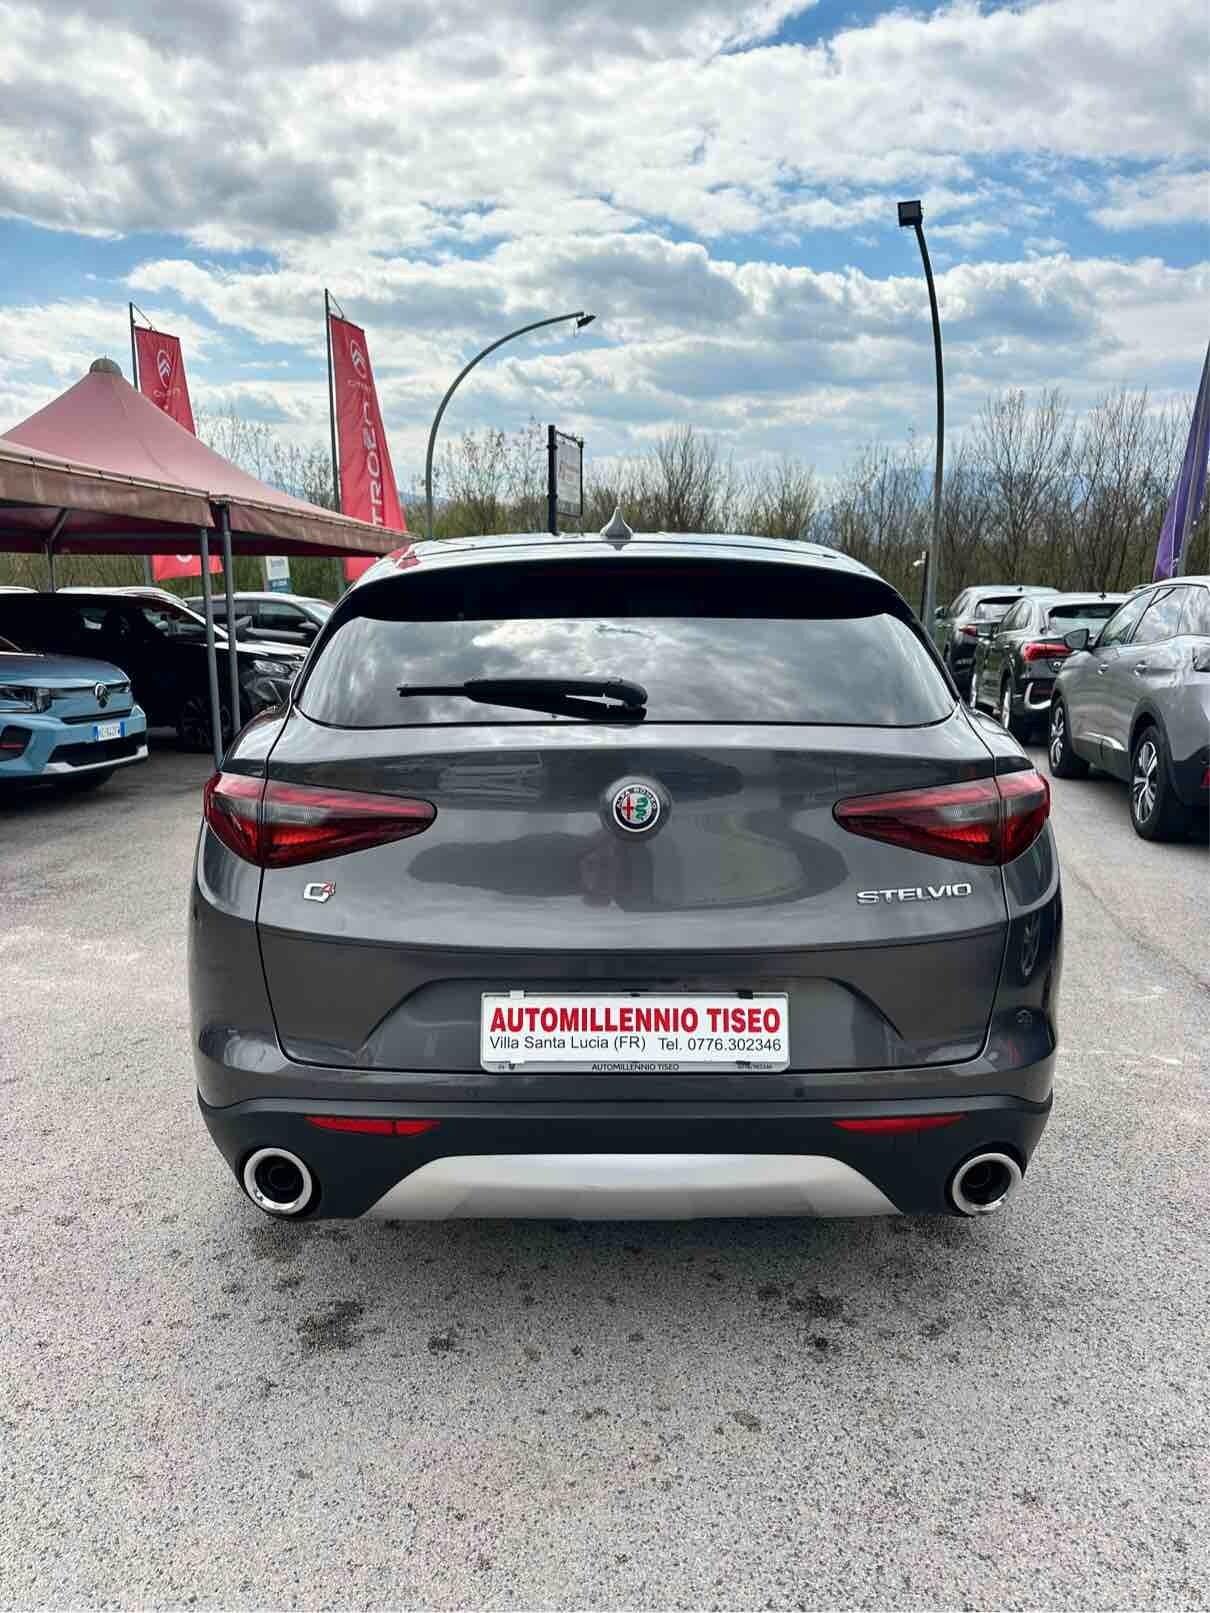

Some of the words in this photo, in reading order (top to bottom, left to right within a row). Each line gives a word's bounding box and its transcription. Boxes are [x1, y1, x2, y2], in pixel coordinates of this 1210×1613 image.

[856, 882, 973, 904] STELVIO
[489, 1007, 699, 1033] AUTOMILLENNIO
[706, 1007, 781, 1034] TISEO
[489, 1035, 520, 1049] Villa
[523, 1034, 566, 1049] Santa
[570, 1035, 609, 1049] Lucia
[613, 1035, 646, 1053] (FR)
[657, 1037, 682, 1051] Tel.
[687, 1037, 782, 1052] 0776.302346
[591, 1062, 656, 1071] AUTOMILLENNIO
[657, 1062, 680, 1071] TISEO
